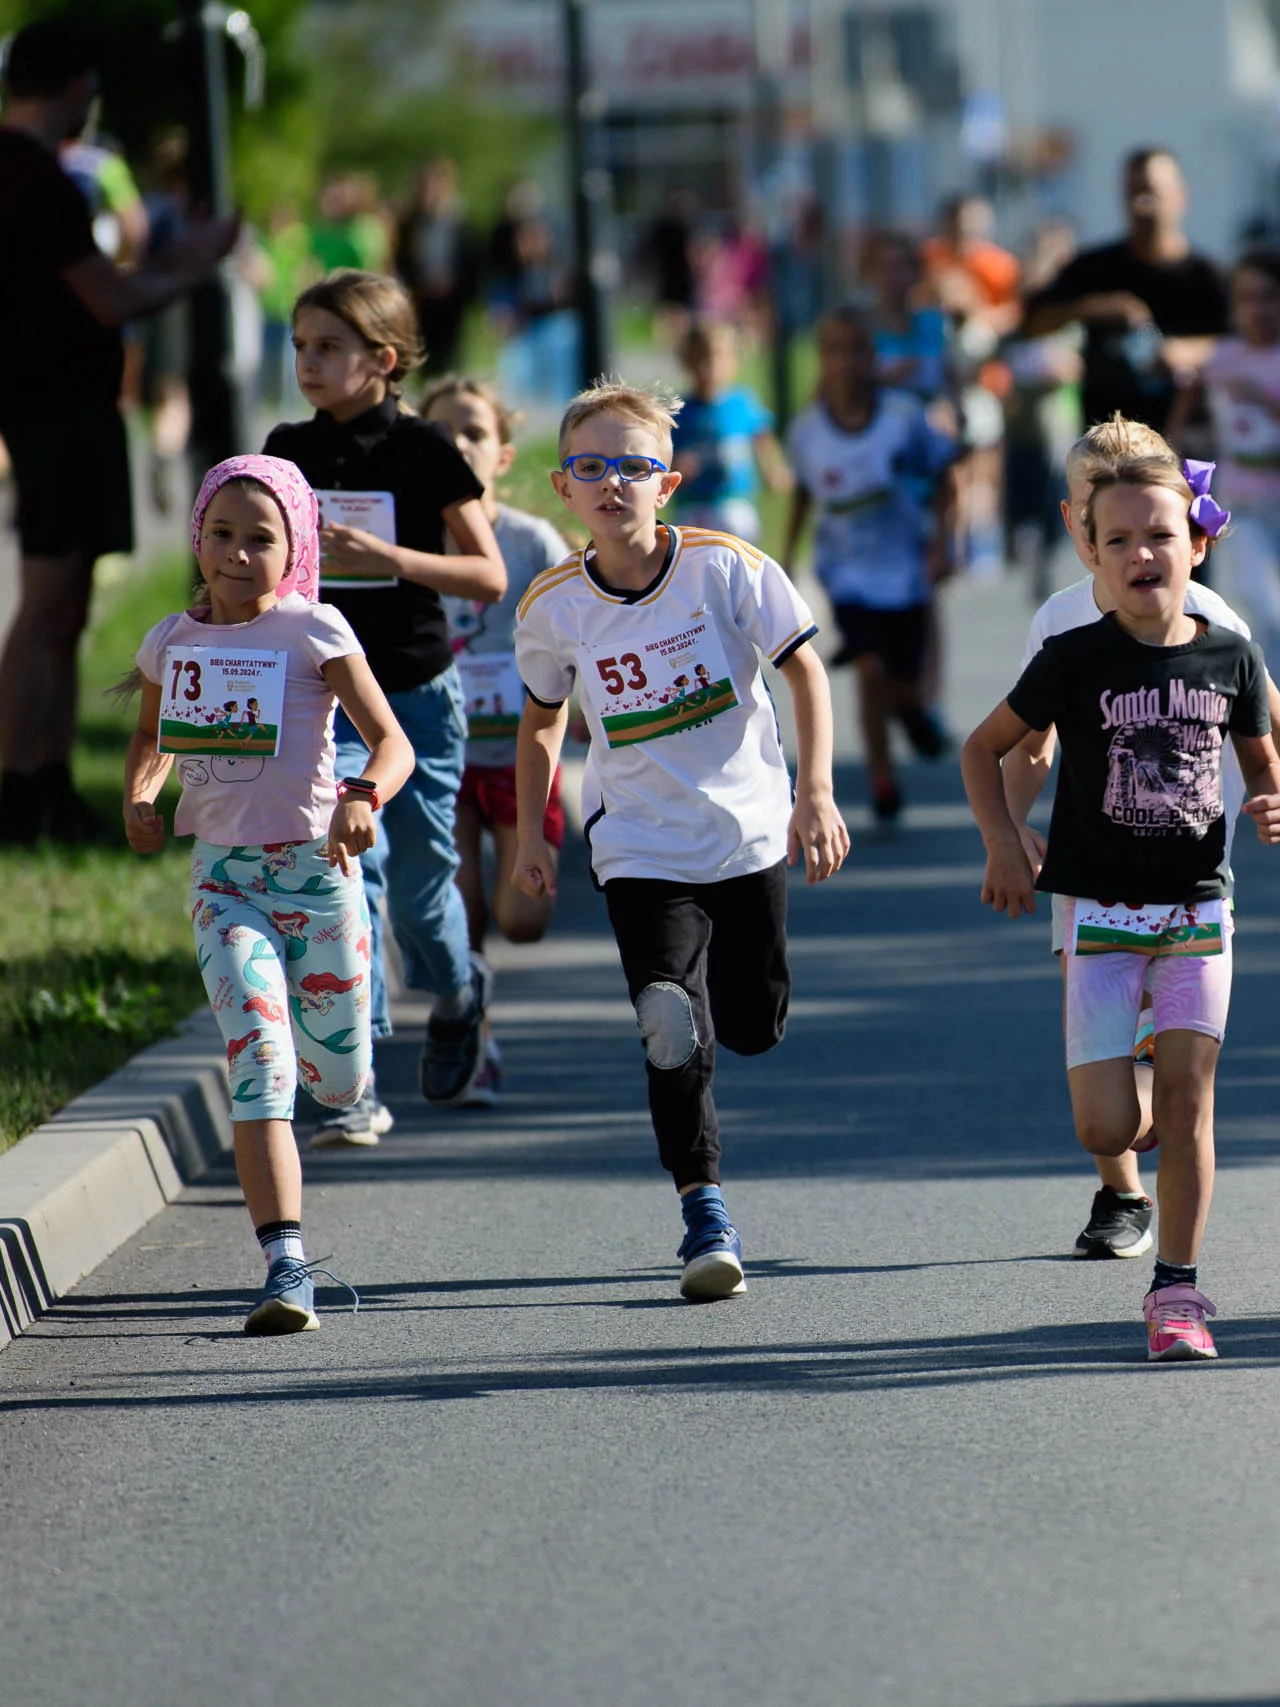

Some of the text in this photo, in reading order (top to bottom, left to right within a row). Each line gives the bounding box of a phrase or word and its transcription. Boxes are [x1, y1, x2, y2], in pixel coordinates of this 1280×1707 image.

[645, 624, 706, 652] BIEG CHARYTATYWNY
[660, 639, 693, 656] 15.09.2024
[210, 659, 277, 669] BIEG CHARYTATYWNY
[222, 668, 256, 676] 15.09.2024
[596, 652, 648, 696] 53
[171, 660, 202, 701] 73
[1100, 685, 1160, 731] Santa
[1112, 805, 1159, 825] COOL
